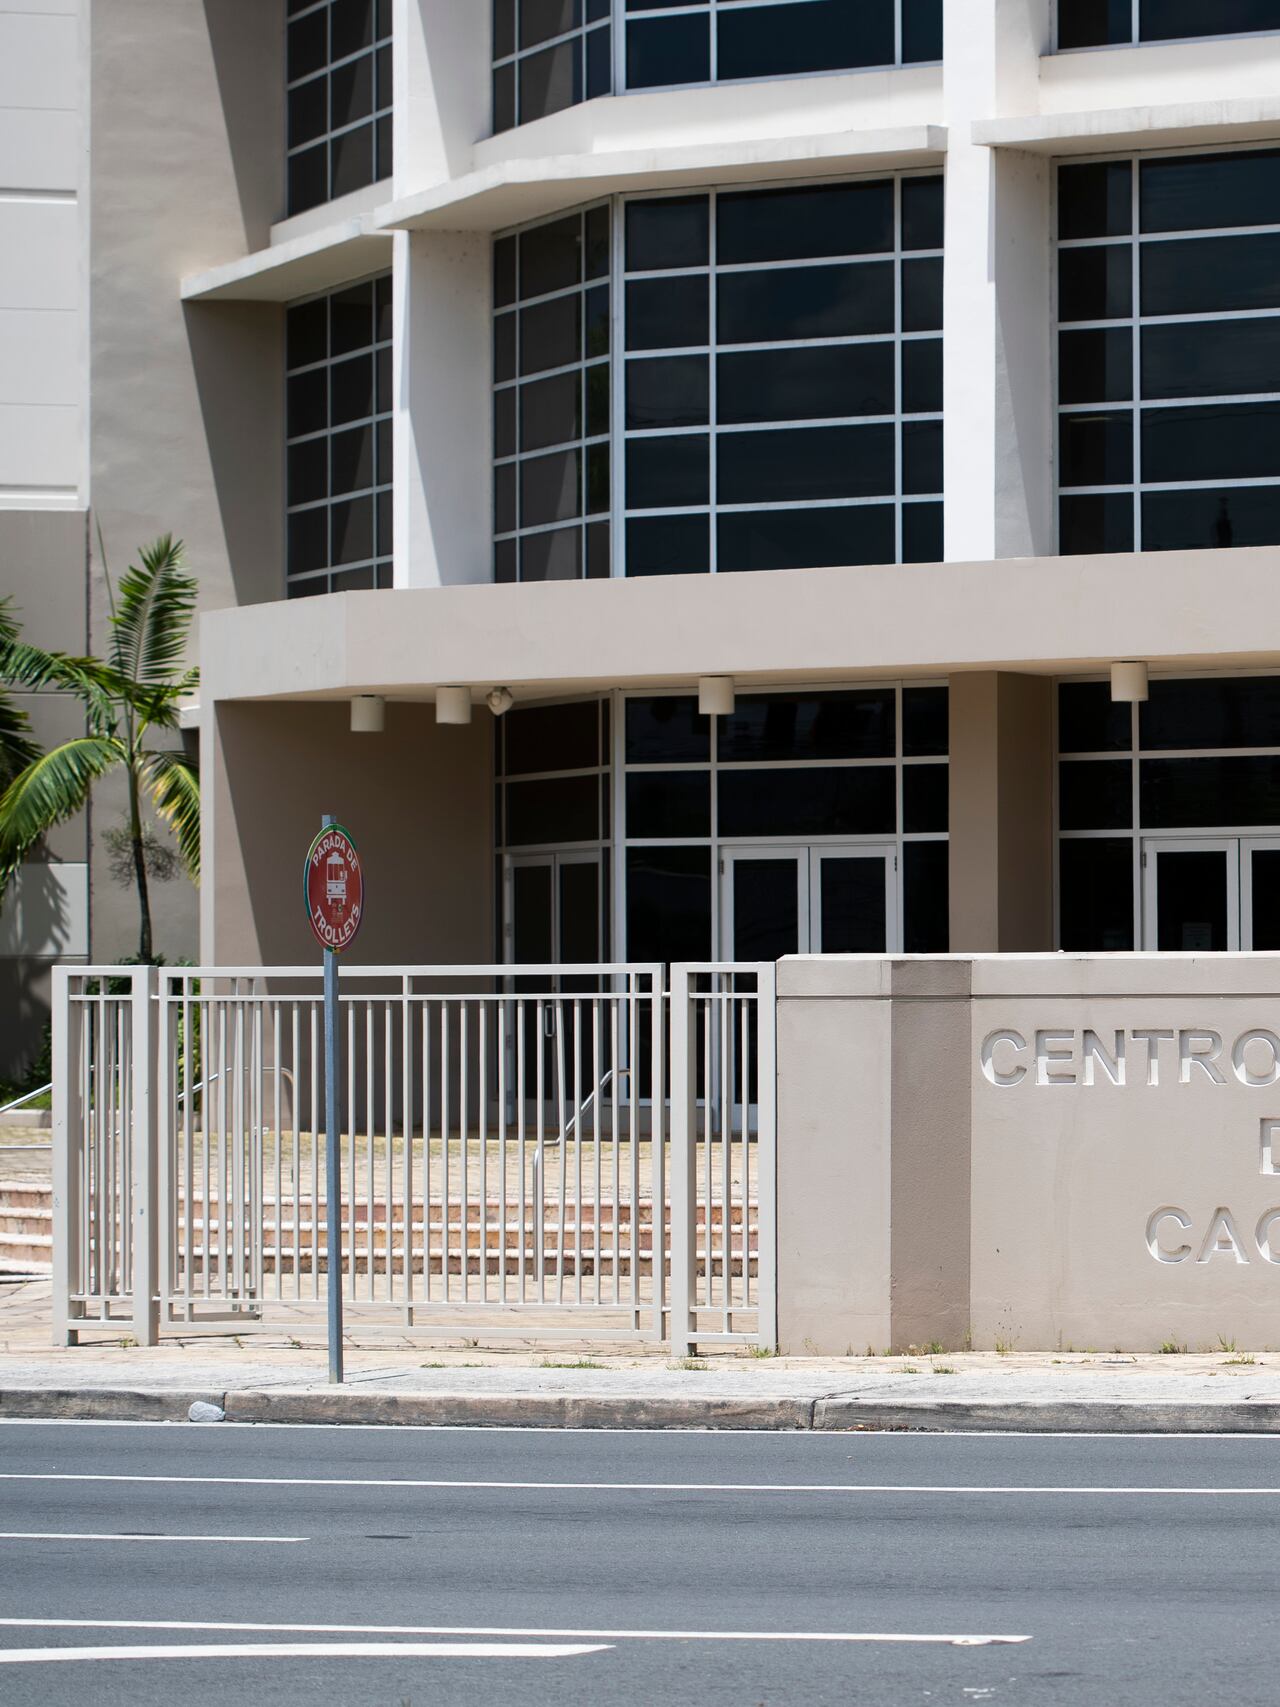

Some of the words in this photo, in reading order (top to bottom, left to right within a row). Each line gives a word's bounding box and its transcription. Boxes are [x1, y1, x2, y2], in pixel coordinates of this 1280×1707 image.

[312, 834, 346, 867] PARADA
[346, 848, 358, 872] DE
[314, 903, 360, 944] TROLLEYS
